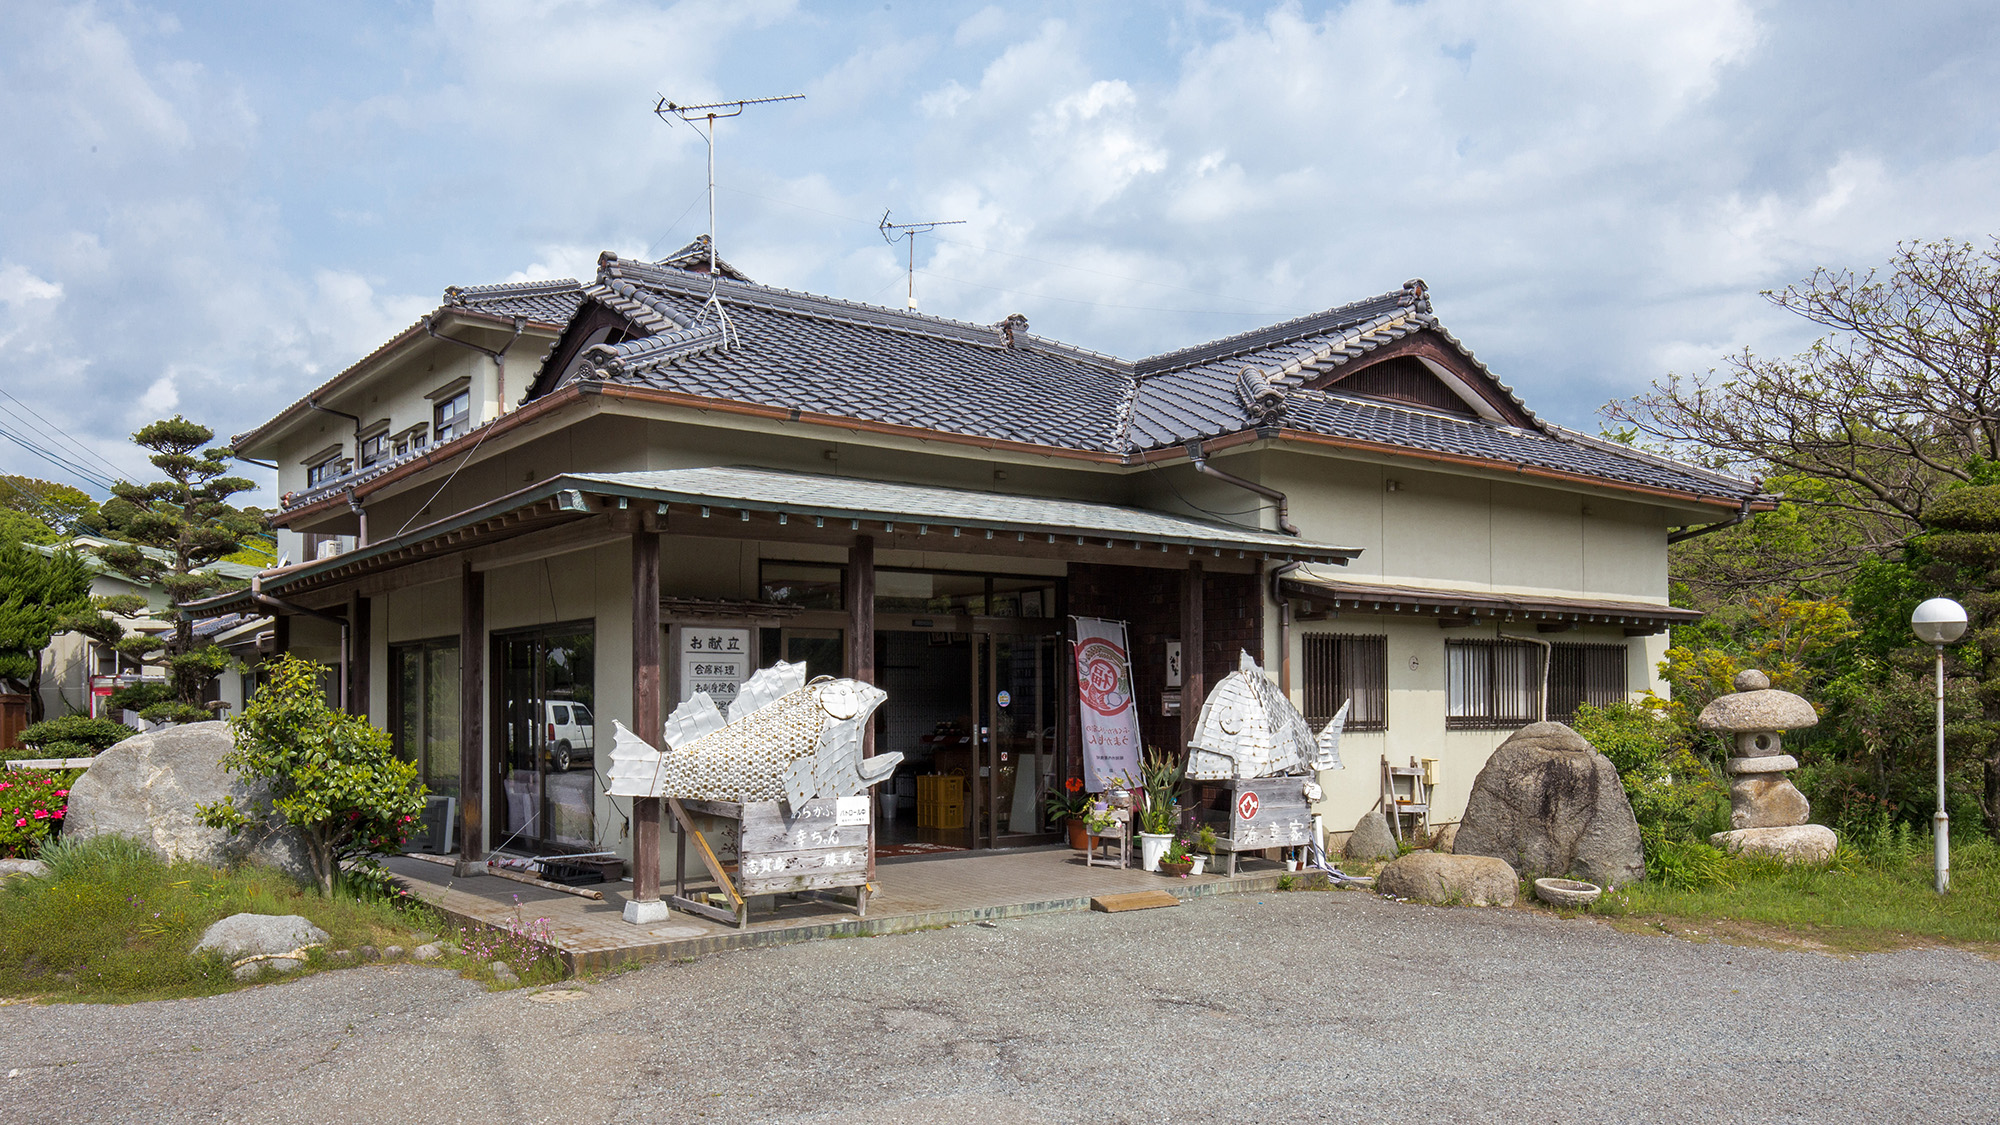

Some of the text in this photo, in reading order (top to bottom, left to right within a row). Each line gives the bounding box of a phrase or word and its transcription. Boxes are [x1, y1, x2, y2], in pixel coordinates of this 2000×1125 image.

[690, 635, 740, 651] お献立
[694, 664, 735, 676] 会席料理
[746, 850, 853, 877] 志賀島 勝馬
